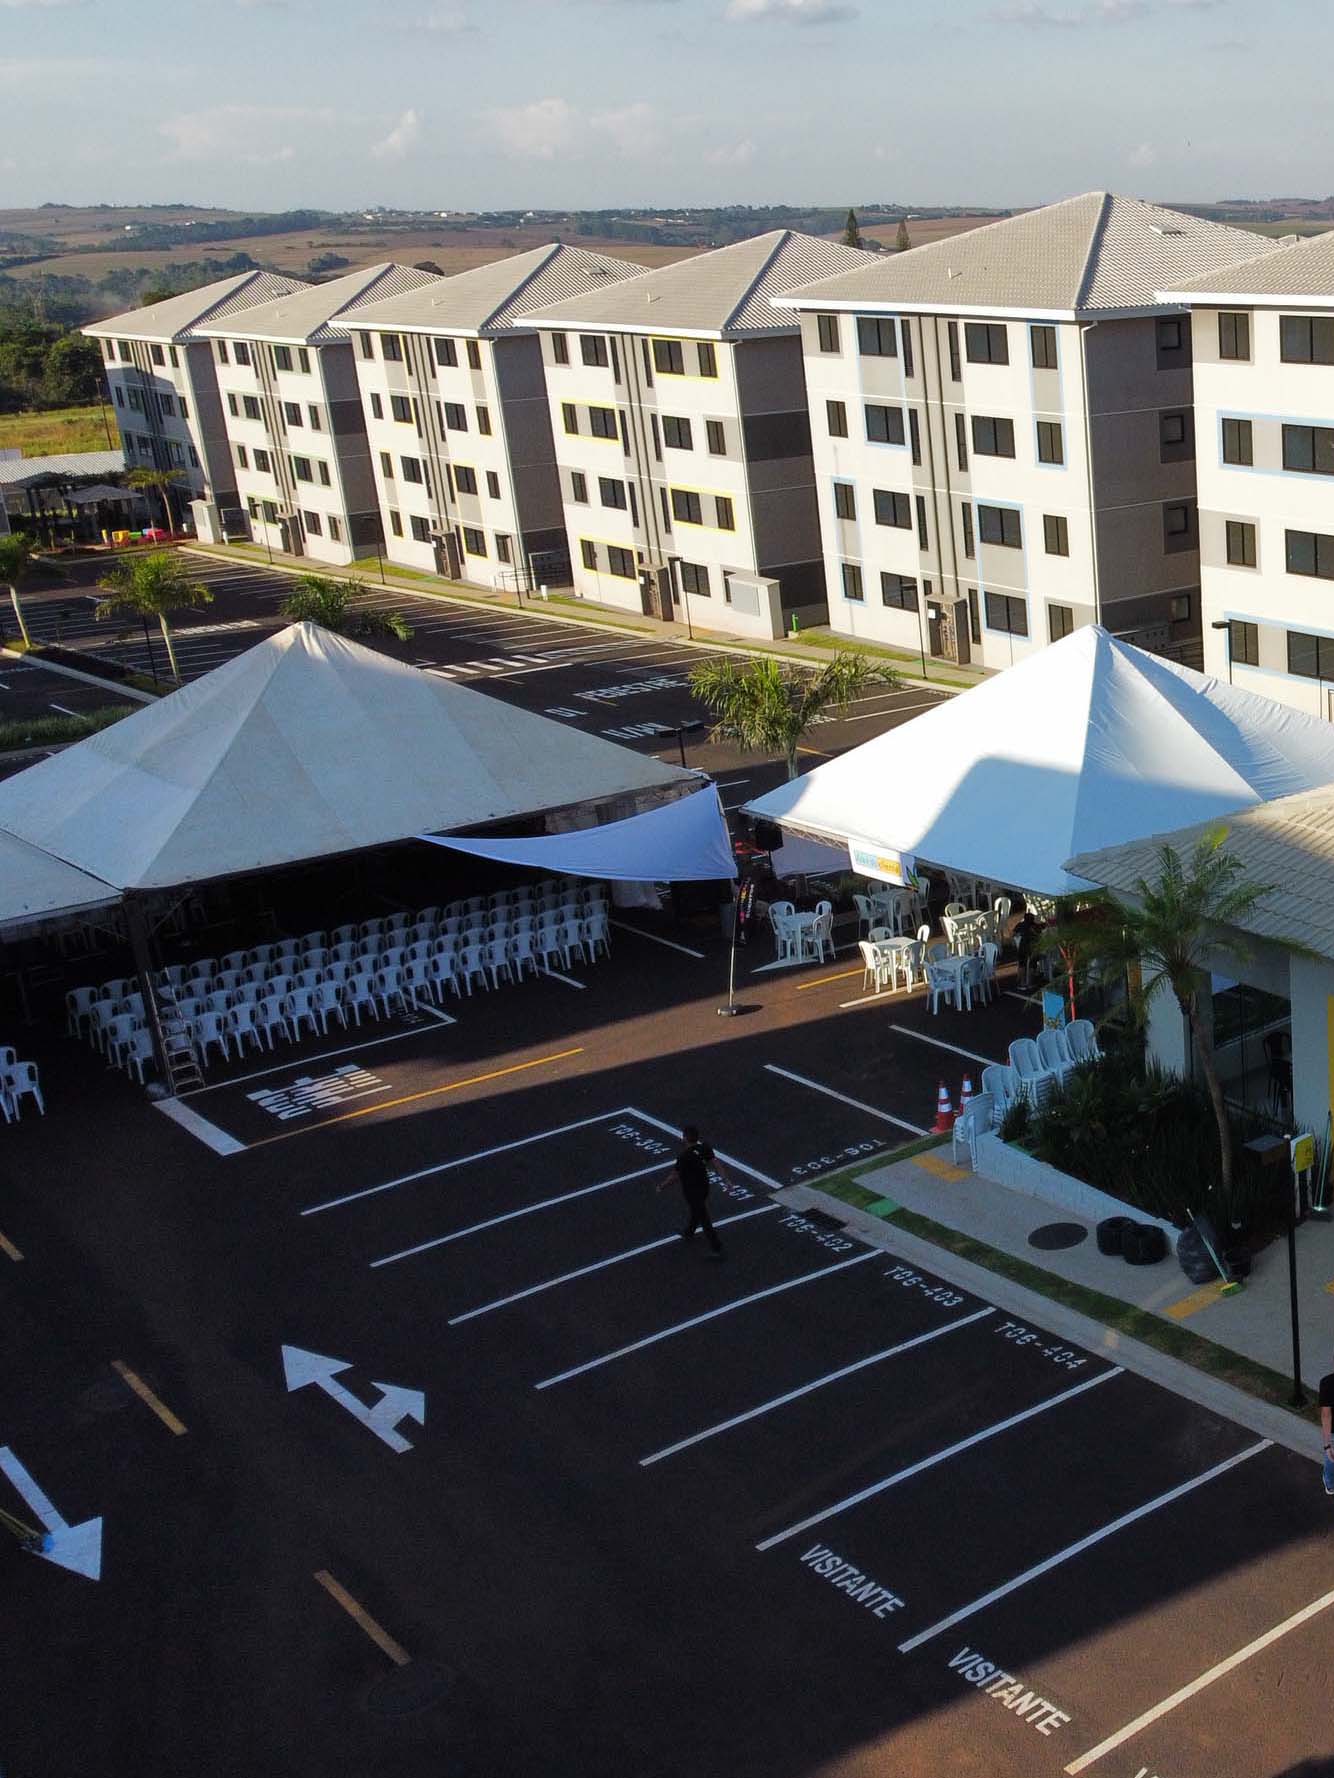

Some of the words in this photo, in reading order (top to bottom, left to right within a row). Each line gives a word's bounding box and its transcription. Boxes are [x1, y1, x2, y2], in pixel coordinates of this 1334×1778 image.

[246, 1064, 392, 1120] PARE
[608, 1124, 672, 1154] T06-304
[792, 1139, 887, 1175] T06-303
[778, 1215, 852, 1252] T06-402
[884, 1266, 963, 1307] T06-403
[994, 1321, 1087, 1369] T06-404
[800, 1544, 905, 1619] VISITANTE
[948, 1647, 1072, 1736] VISITANTE
